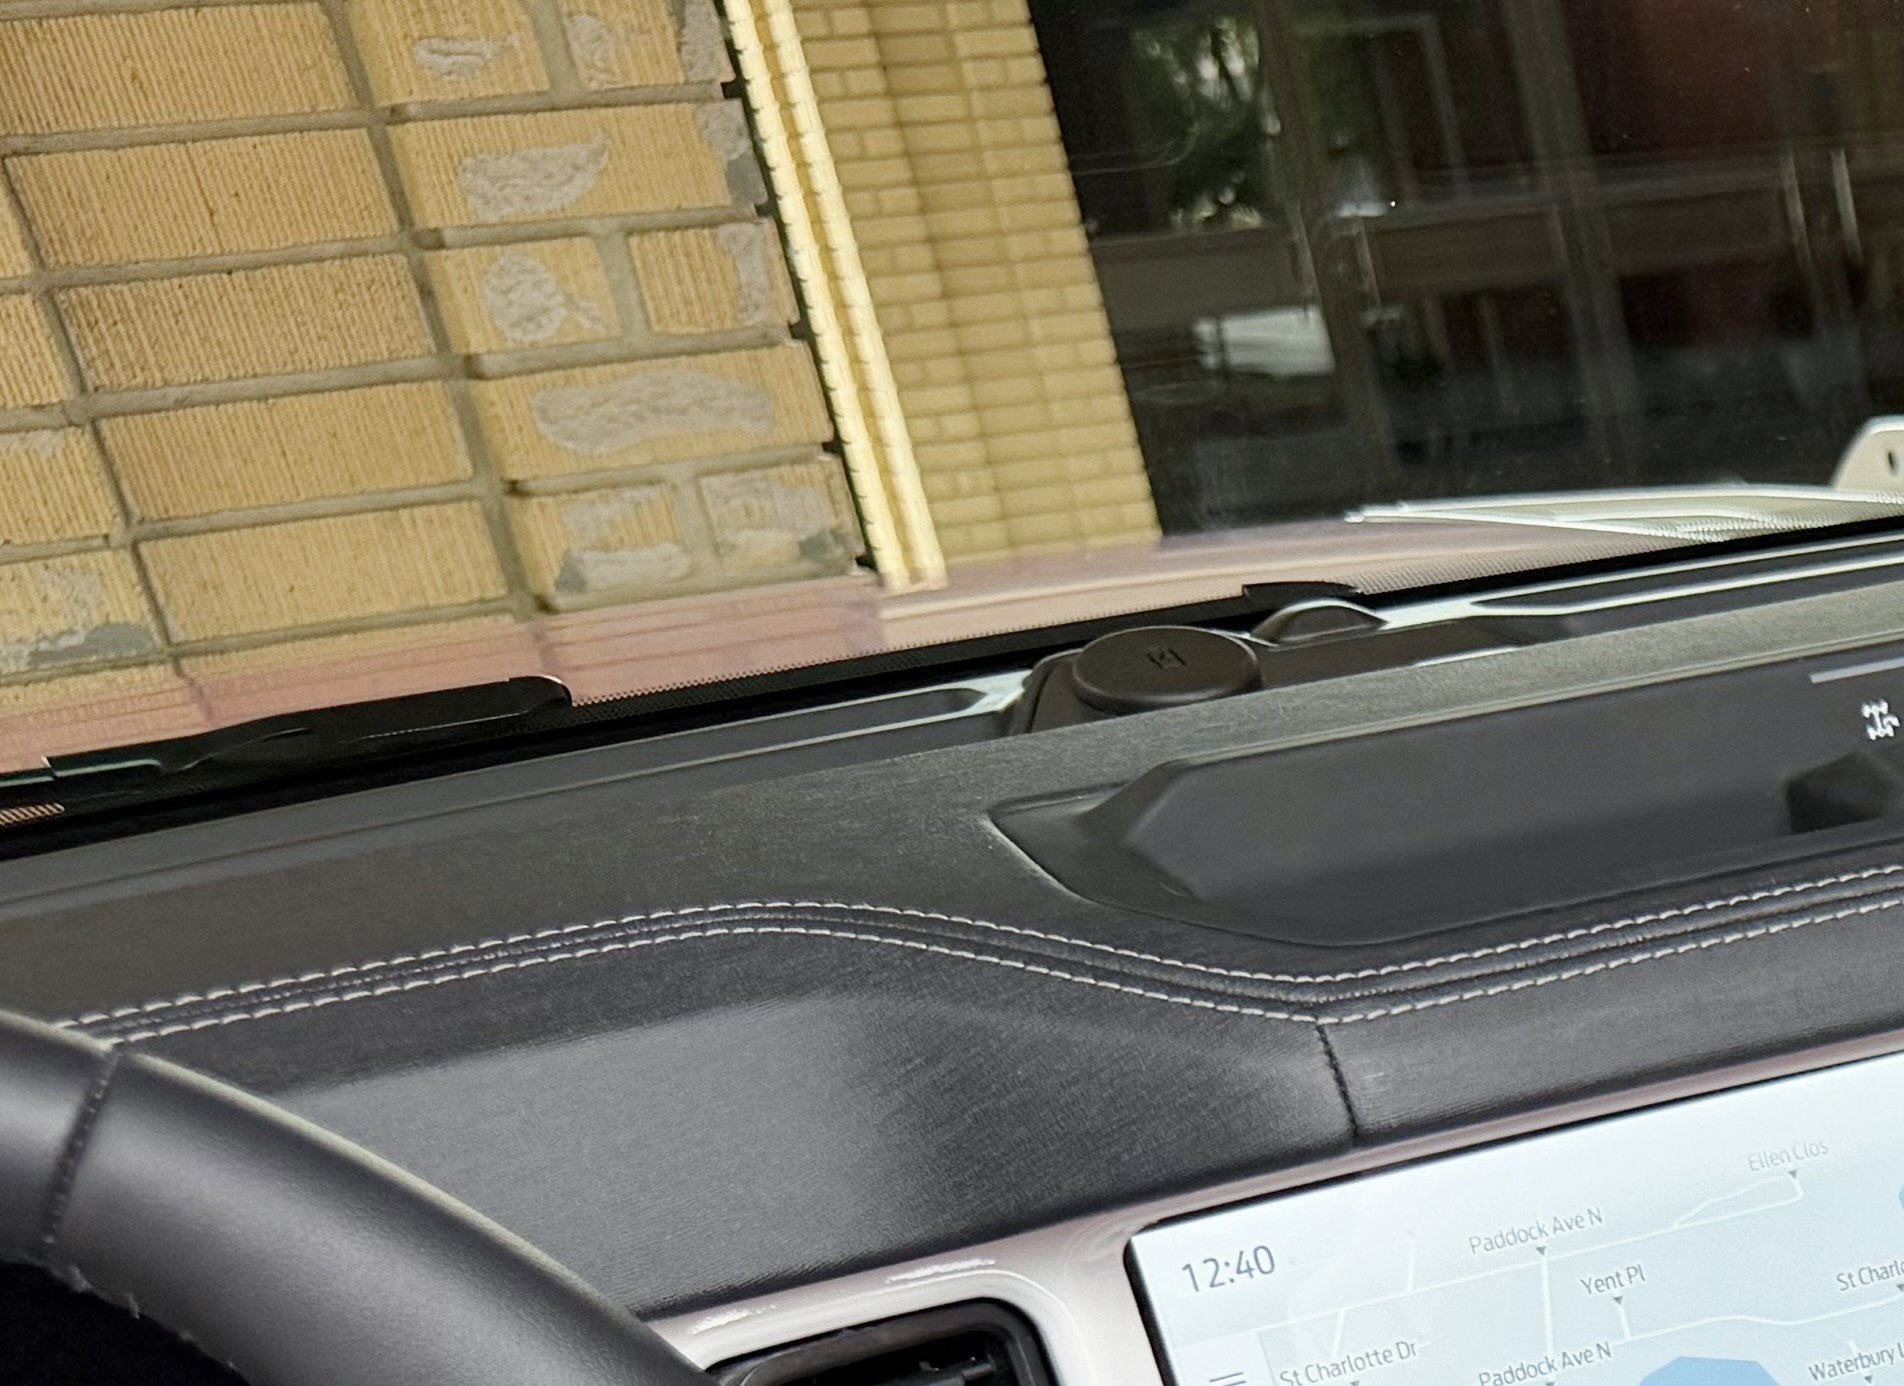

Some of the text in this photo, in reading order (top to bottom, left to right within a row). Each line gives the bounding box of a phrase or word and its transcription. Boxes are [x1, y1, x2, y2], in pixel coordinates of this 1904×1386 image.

[1749, 1147, 1790, 1173] Ellen
[1469, 1207, 1604, 1255] Paddock Ave N
[1182, 1245, 1276, 1292] 12:40
[1580, 1263, 1646, 1296] Yent Pl
[1836, 1271, 1857, 1292] St
[1305, 1348, 1393, 1385] Charlotte
[1396, 1341, 1418, 1359] Dr
[1561, 1349, 1594, 1370] Ave
[1596, 1341, 1613, 1359] N
[1808, 1346, 1895, 1383] Waterbury
